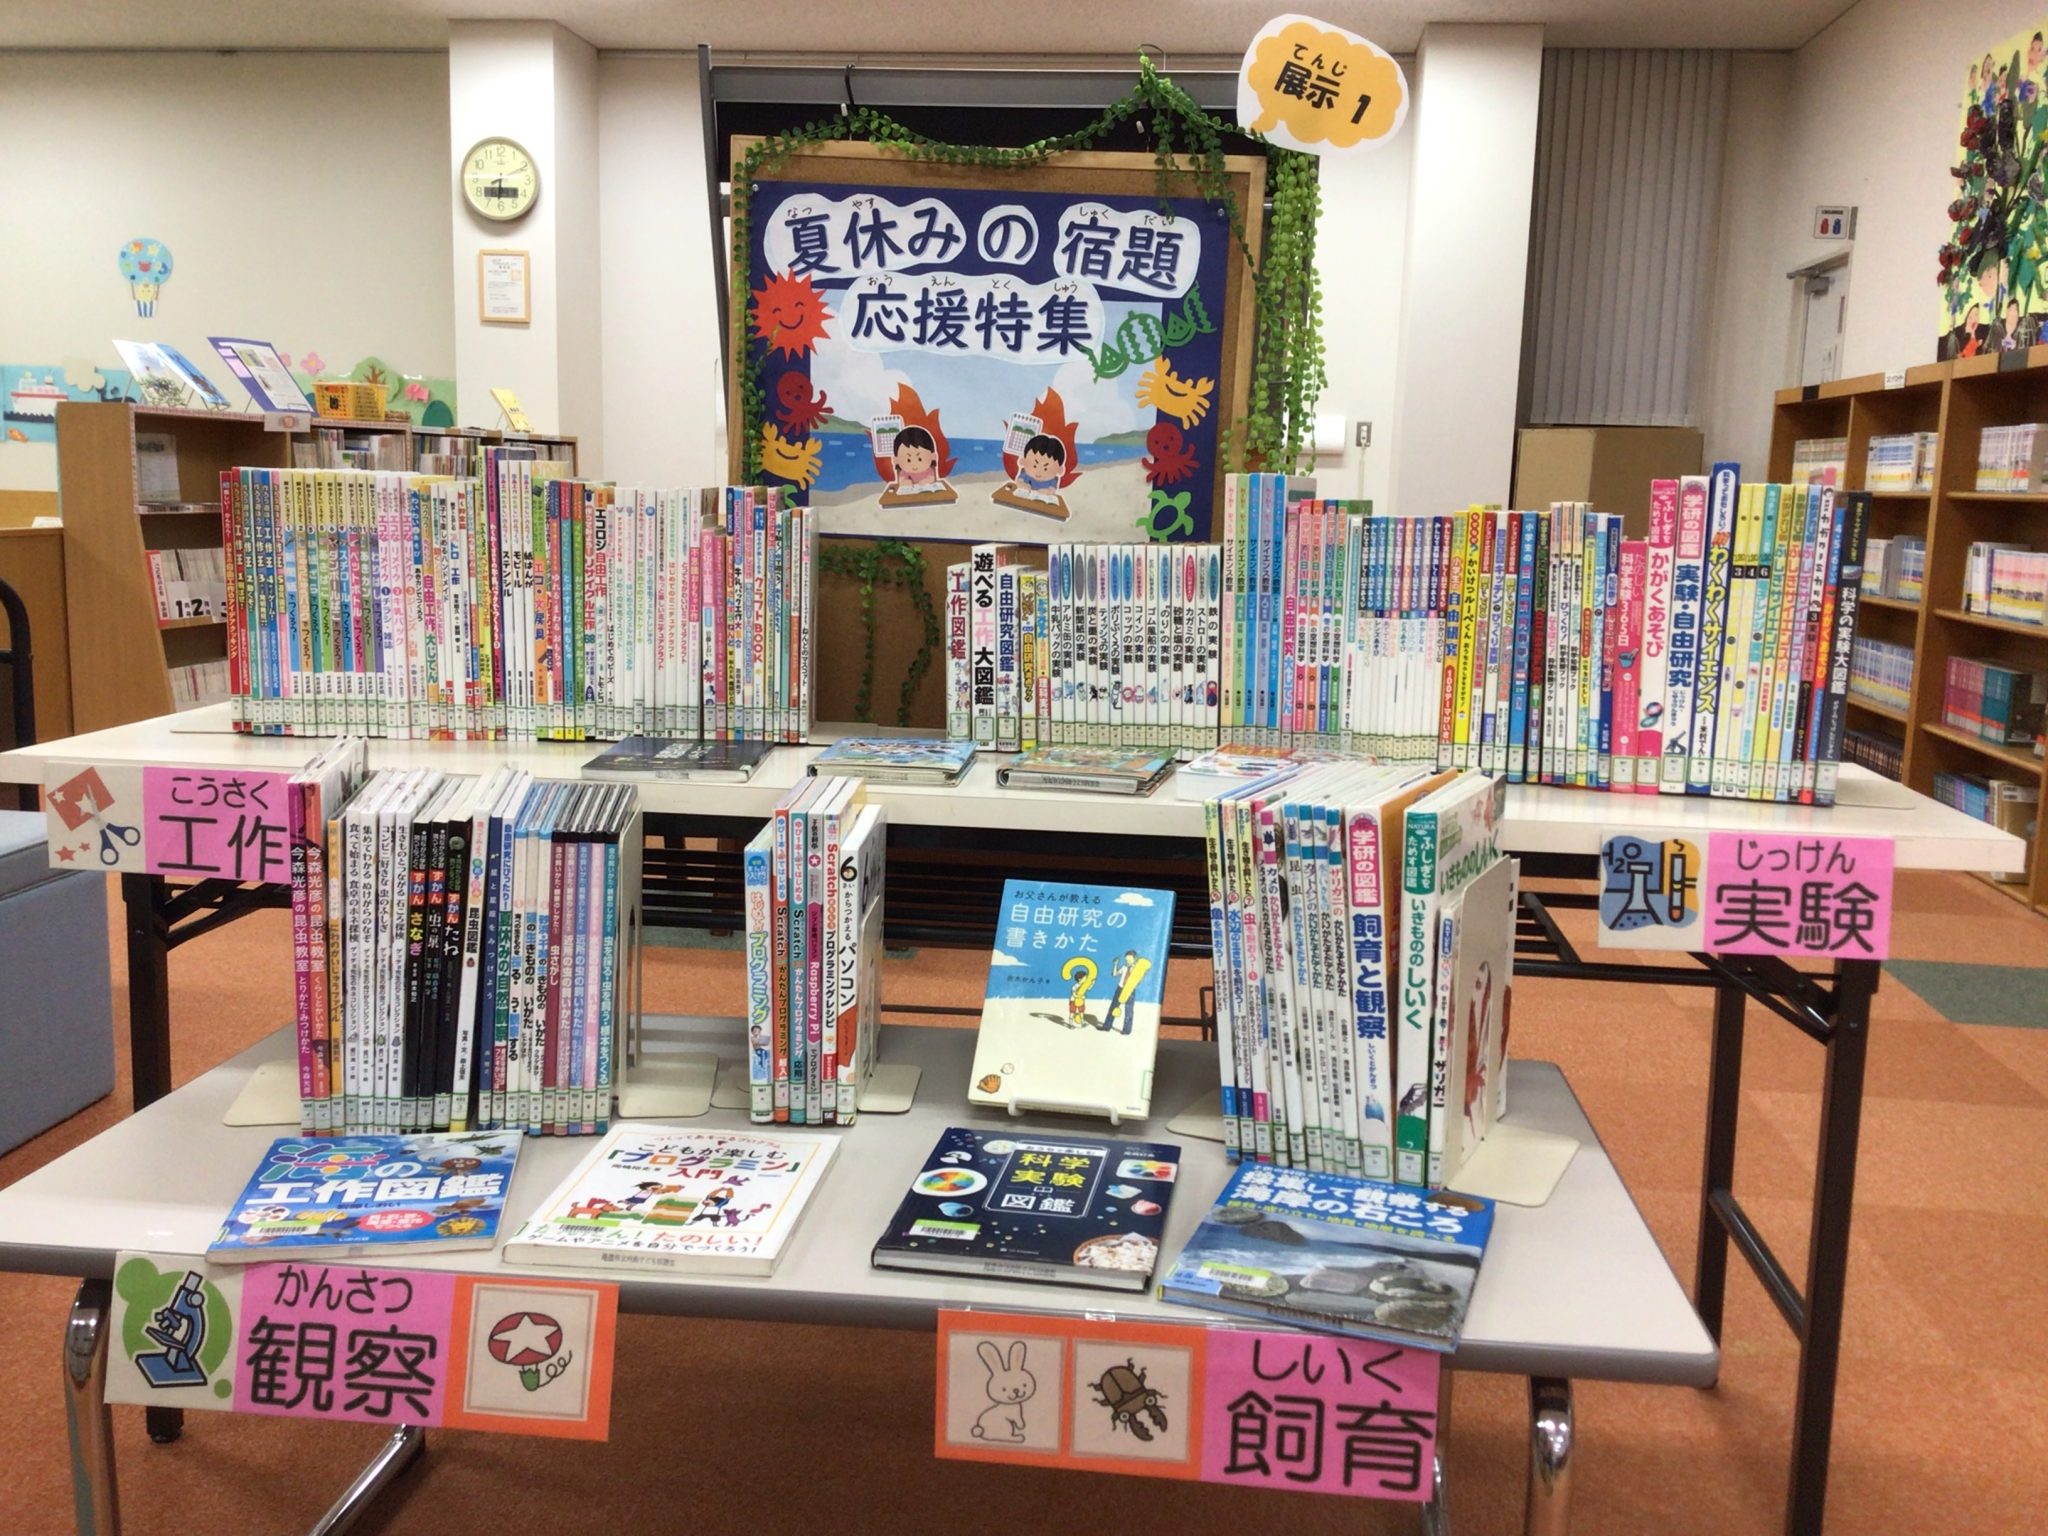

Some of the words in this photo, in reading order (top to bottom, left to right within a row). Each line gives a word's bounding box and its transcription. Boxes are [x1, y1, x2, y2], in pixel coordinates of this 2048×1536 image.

[1293, 43, 1348, 77] てんじ
[1274, 60, 1341, 110] 展示
[1351, 94, 1372, 124] 1
[786, 207, 813, 218] なつ
[852, 198, 876, 209] やす
[1079, 206, 1110, 220] しゅく
[784, 206, 1184, 291] 夏休みの宿題
[867, 275, 893, 287] おう
[931, 275, 956, 287] えん
[991, 279, 1011, 291] とく
[1053, 281, 1079, 294] しゅう
[851, 283, 1092, 356] 応援特集
[1661, 500, 1675, 544] ふしぎを
[1678, 494, 1704, 558] 学研の図鑑
[503, 551, 512, 597] ステンシル
[513, 551, 522, 588] モビール
[523, 552, 533, 588] 紙はんが
[1734, 567, 1742, 576] 3
[1760, 567, 1769, 576] 6
[950, 570, 966, 660] 工作図鑑
[999, 573, 1014, 672] 自由研究図鑑
[1617, 553, 1634, 647] 科学実験365日
[1646, 552, 1670, 658] かがくあそび
[1668, 564, 1701, 688] 実験・自由研究
[1765, 544, 1788, 659] ふしぎサイエンス
[1778, 543, 1800, 661] ふしぎサイエンス
[974, 552, 994, 705] 遊べる工作大図鑑
[1051, 606, 1061, 677] 牛乳パックの実験
[1063, 605, 1072, 668] アルミ缶の実験
[1076, 606, 1085, 661] 新聞紙の実験
[1124, 606, 1133, 664] コップの実験
[1135, 606, 1144, 663] コインの実験
[1147, 608, 1156, 672] ゴム風船の実験
[1185, 608, 1194, 664] カガミの実験
[1197, 607, 1206, 673] ストローの実験
[1208, 607, 1218, 659] 鉄の実験
[1696, 545, 1729, 714] わくわくサイエンス
[1830, 587, 1857, 695] 科学の実験大図鑑
[425, 634, 438, 683] 大じてん
[801, 628, 809, 686] ねんどのマスコット
[172, 776, 269, 810] こうさく
[157, 814, 288, 881] 工作
[349, 823, 360, 877] 食べて始まる
[362, 825, 373, 879] 集めてわかる
[827, 844, 838, 897] Scratch
[840, 856, 858, 882] 6
[1353, 829, 1379, 904] 学研の図鑑
[1406, 836, 1419, 888] ためす図鑑
[1420, 836, 1435, 889] ふしぎを
[1736, 839, 1856, 874] じっけん
[1013, 889, 1102, 905] お父さんが教える
[1266, 867, 1280, 894] カメの
[1330, 868, 1343, 917] ザリガニの
[291, 846, 310, 972] 今森光彦の昆虫教室
[307, 846, 325, 972] 今森光彦の昆虫教室
[349, 880, 359, 943] 食卓のホネ探検
[362, 881, 372, 944] ぬけがらのなぞ
[394, 899, 406, 941] 石ころ探検
[409, 912, 424, 957] さなぎ
[466, 907, 480, 954] 昆虫図鑑
[777, 906, 788, 956] Scratch
[794, 909, 805, 959] Scratch
[844, 891, 854, 942] からつかえる
[1010, 903, 1128, 930] 自由研究の
[1713, 878, 1880, 953] 実験
[443, 926, 461, 957] たね
[549, 945, 560, 986] 虫さがし
[1004, 926, 1101, 953] 書きかた
[1404, 898, 1428, 1031] いきもののしいく
[748, 931, 769, 1024] プログラミング
[809, 961, 821, 1020] Raspberry
[825, 931, 837, 1028] プログラミングレシピ
[838, 943, 858, 1007] パソコン
[1351, 913, 1386, 1040] 飼育と観察
[298, 976, 310, 1054] とりかた・みつけかた
[314, 976, 324, 1039] くらしとかいかた
[777, 966, 788, 1056] かんたんプログラミング
[793, 967, 804, 1057] かんたんプログラミング
[809, 1024, 820, 1035] Pi
[638, 1143, 788, 1160] こどもが楽しむ
[667, 1167, 724, 1180] 入門
[1018, 1153, 1091, 1170] 科学
[244, 1172, 504, 1206] 工作図鑑
[1000, 1193, 1076, 1214] 図鑑
[1010, 1169, 1087, 1188] 実験
[1230, 1185, 1464, 1234] 海岸の石ころ
[527, 1233, 757, 1254] ゲームやアニメを自分でつくろう！
[273, 1264, 413, 1315] かんさつ
[247, 1315, 437, 1418] 観察
[1253, 1339, 1404, 1392] しいく
[1223, 1390, 1436, 1492] 飼育
